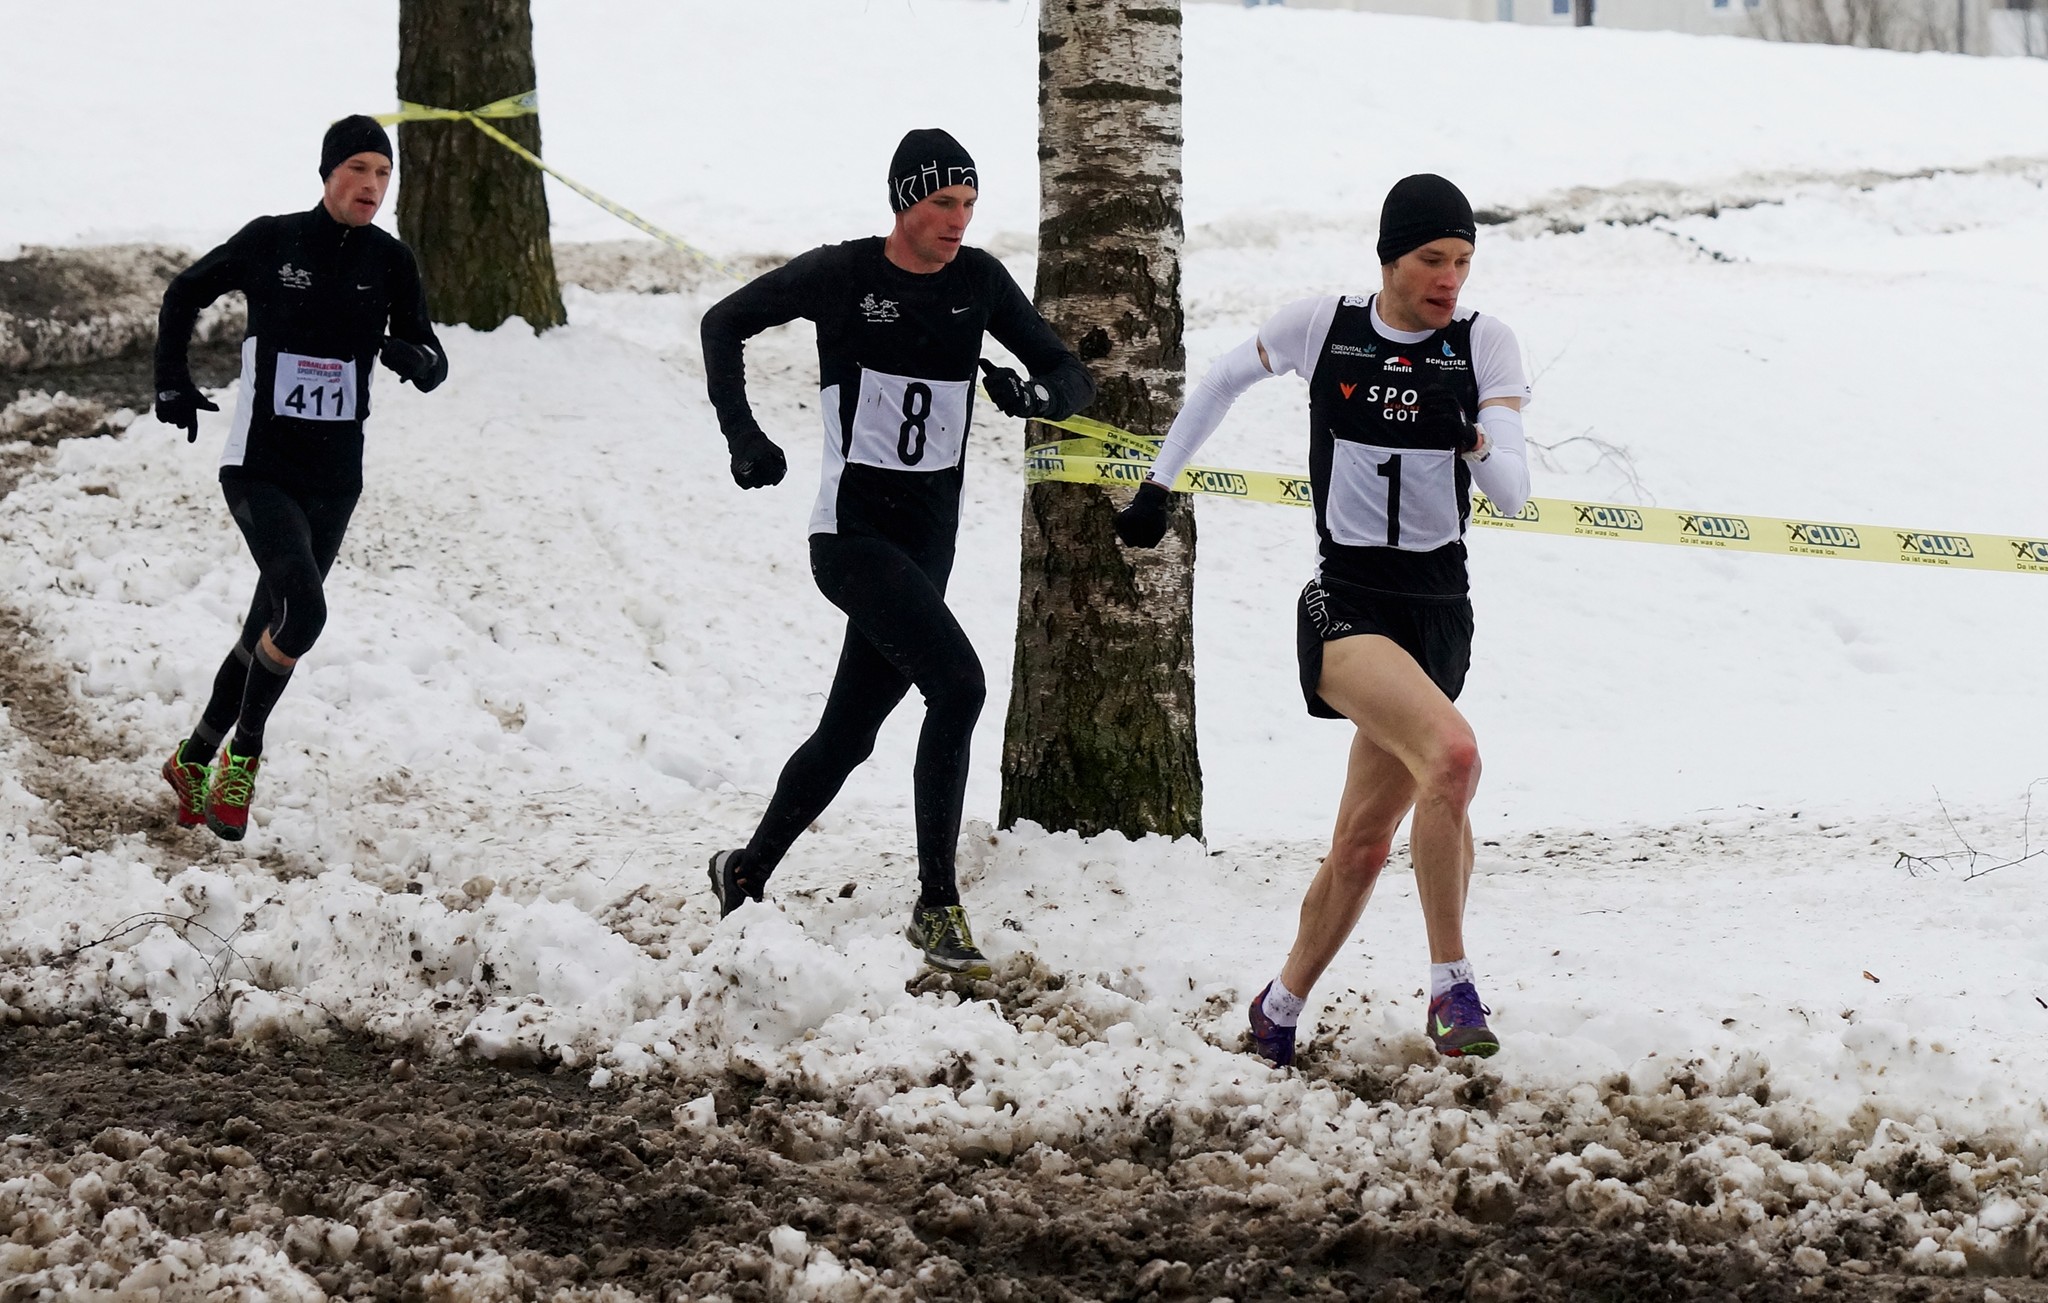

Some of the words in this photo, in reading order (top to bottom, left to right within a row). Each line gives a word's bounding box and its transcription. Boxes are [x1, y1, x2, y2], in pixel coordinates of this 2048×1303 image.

[1383, 364, 1413, 373] skinfit
[284, 384, 344, 417] 411
[897, 381, 933, 467] 8
[1201, 472, 1248, 495] CLUB
[1377, 453, 1402, 547] 1
[1592, 507, 1643, 529] CLUB
[1697, 516, 1749, 539] CLUB
[1805, 525, 1859, 547] CLUB
[1916, 534, 1973, 557] CLUB
[1901, 554, 1911, 562] Da
